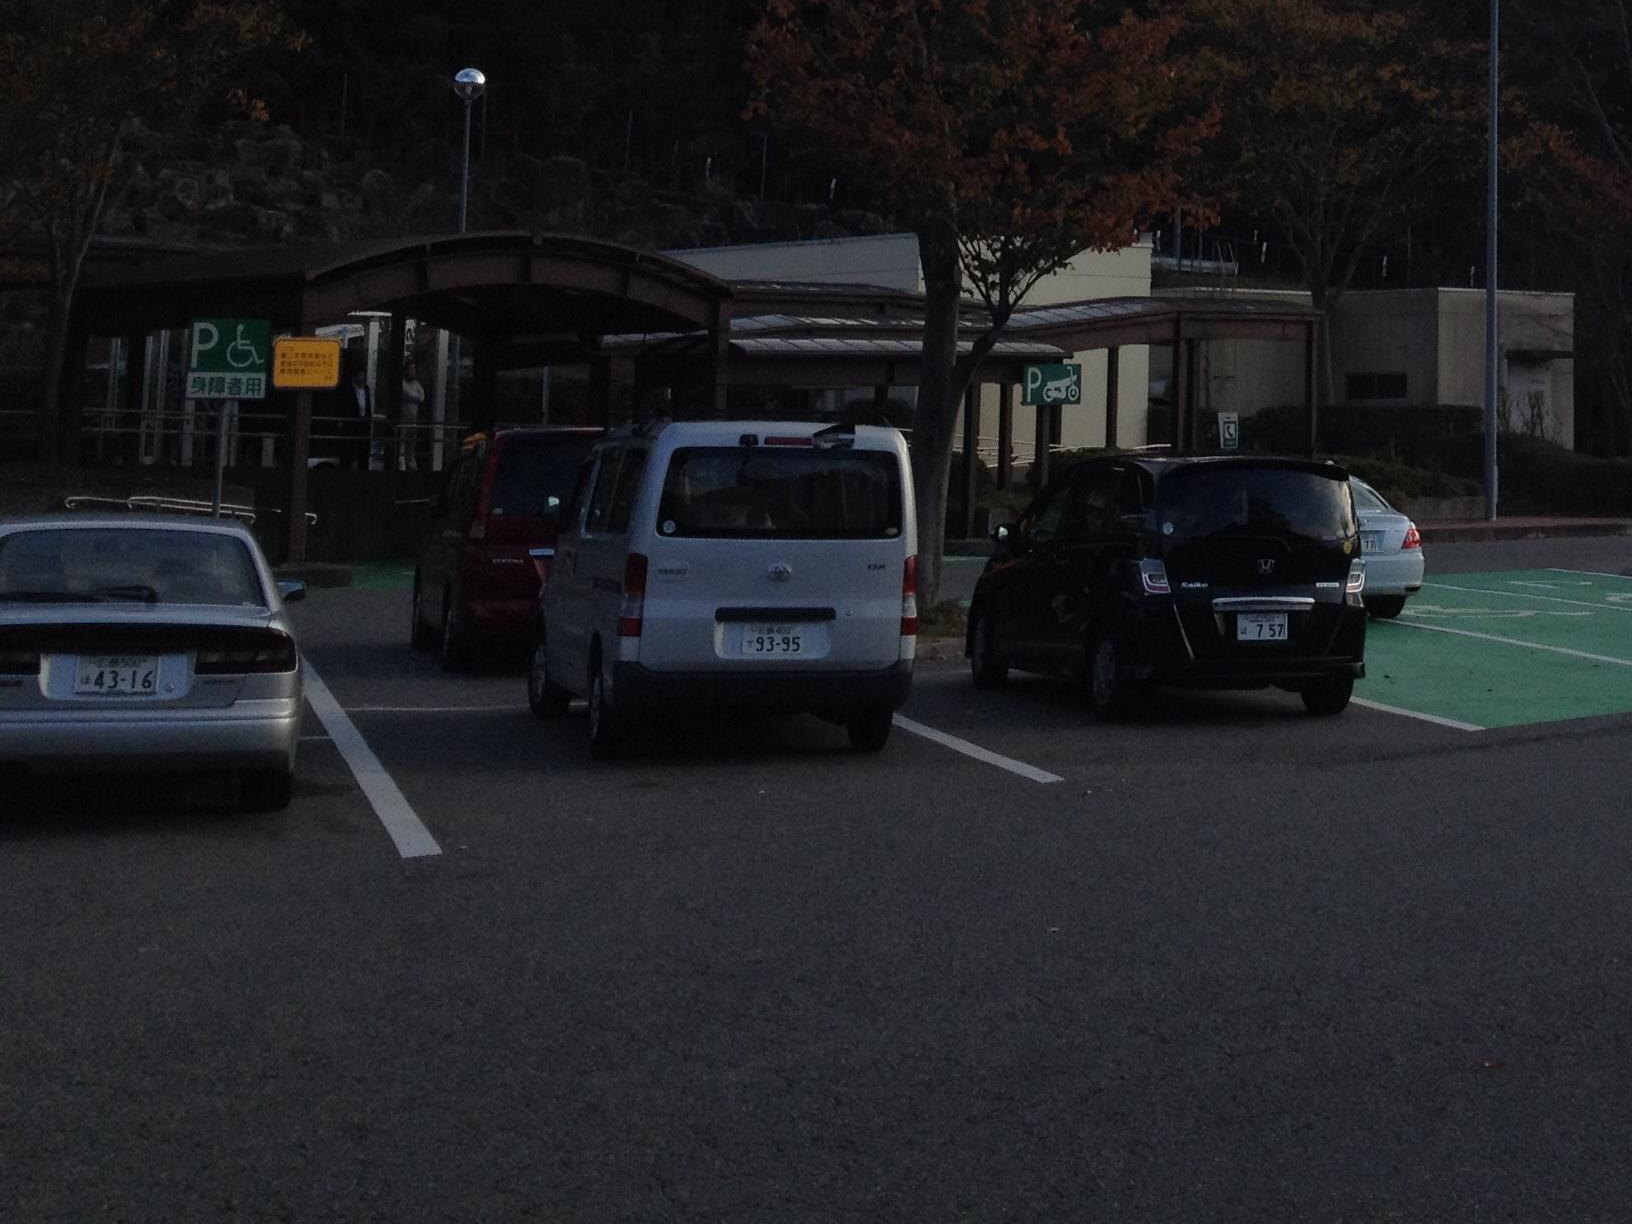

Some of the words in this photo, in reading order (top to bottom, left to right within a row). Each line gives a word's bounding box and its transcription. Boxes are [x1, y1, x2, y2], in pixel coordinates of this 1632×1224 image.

[191, 322, 219, 368] P
[191, 377, 261, 396] 身障者用
[1027, 367, 1042, 403] P
[756, 636, 800, 652] 93-95
[94, 670, 153, 689] 43-16
